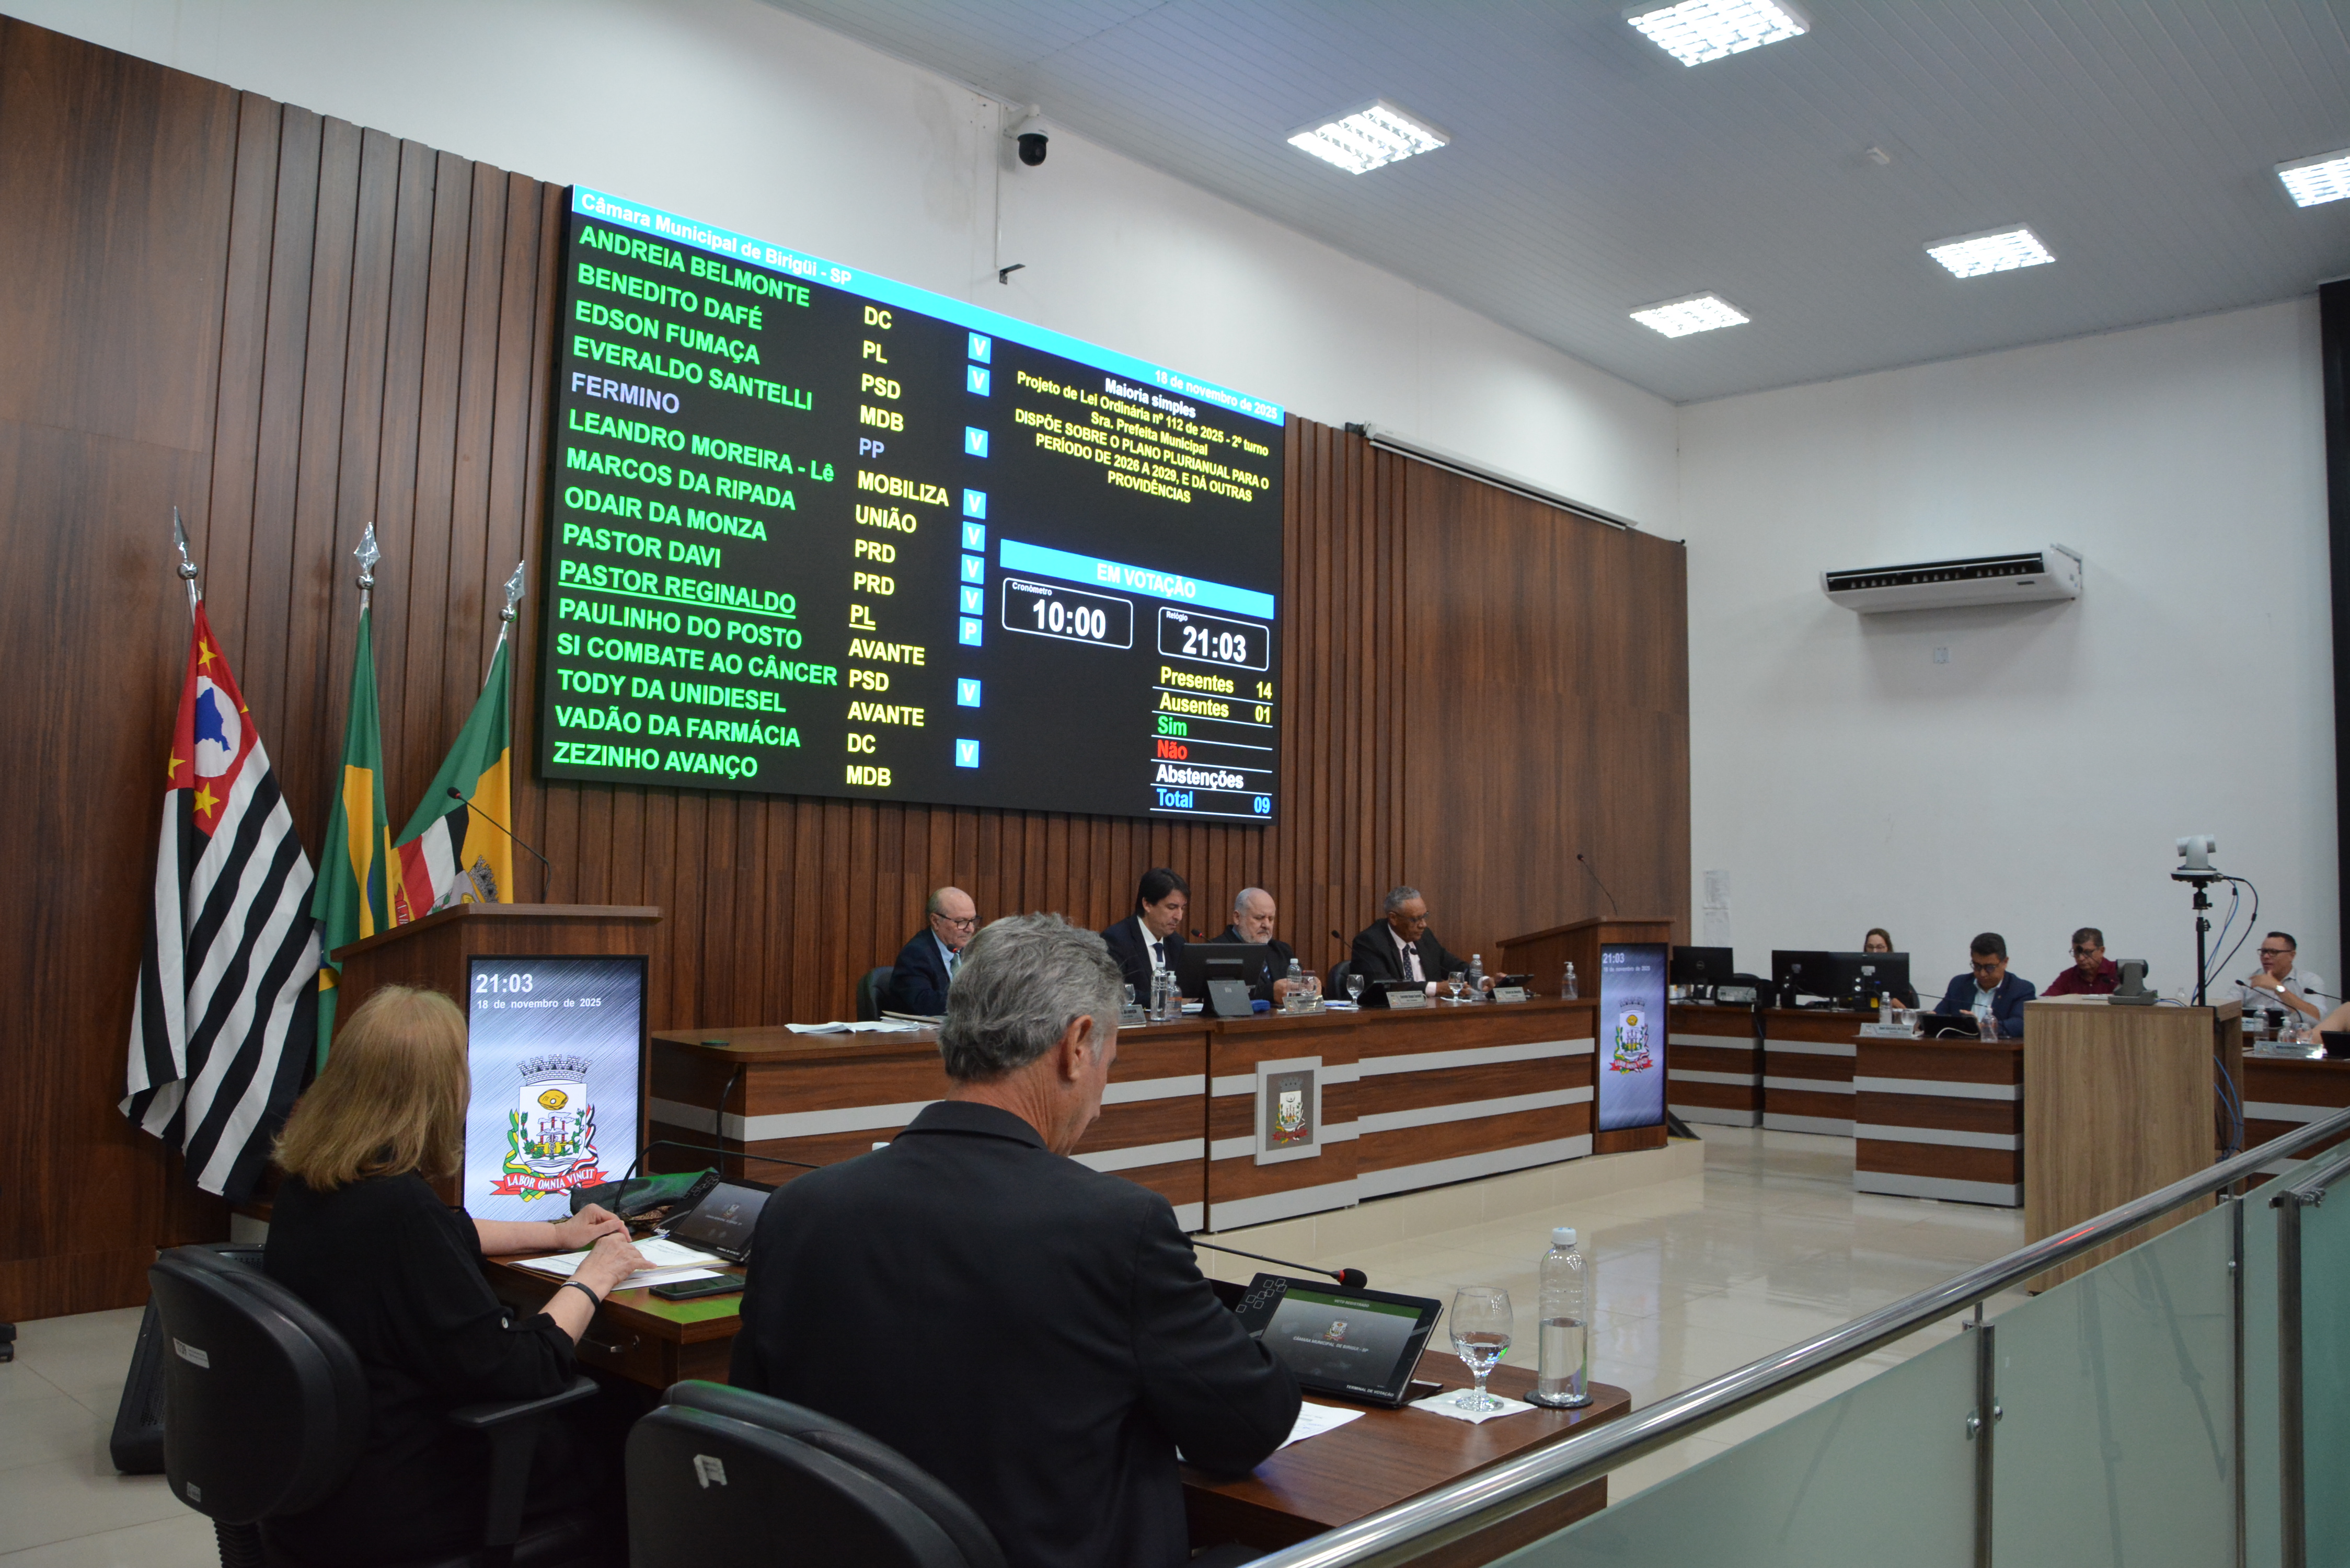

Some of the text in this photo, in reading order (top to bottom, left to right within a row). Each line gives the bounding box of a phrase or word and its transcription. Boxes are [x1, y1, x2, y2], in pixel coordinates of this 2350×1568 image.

[582, 194, 650, 227] Câmara
[655, 214, 737, 253] Municipal
[741, 242, 761, 259] de
[766, 248, 816, 276] Birigüi
[830, 268, 851, 285] SP
[579, 225, 810, 307] ANDREIA BELMONTE
[578, 263, 762, 330] BENEDITO DAFÉ
[865, 306, 892, 329] DC
[575, 300, 760, 365] EDSON FUMAÇA
[863, 340, 888, 364] PL
[974, 338, 986, 356] V
[573, 335, 812, 410] EVERALDO SANTELLI
[862, 373, 901, 399] PSD
[973, 371, 985, 389] V
[572, 372, 679, 413] FERMINO
[1105, 378, 1196, 418] Maioria simples
[1155, 370, 1277, 419] 18 de novembro de 2025
[860, 405, 904, 432] MDB
[1018, 371, 1060, 395] Projeto
[1063, 386, 1077, 400] de
[1081, 389, 1097, 406] Lei
[1100, 396, 1150, 421] Ordinária
[1153, 413, 1164, 424] nº
[1166, 416, 1183, 431] 112
[1185, 422, 1198, 435] de
[1200, 426, 1224, 443] 2025
[1231, 435, 1242, 447] 2º
[1243, 439, 1269, 456] turno
[569, 409, 685, 451] LEANDRO
[692, 434, 792, 474] MOREIRA
[811, 460, 834, 482] Lê
[859, 437, 884, 458] PP
[971, 432, 983, 450] V
[1091, 412, 1207, 456] Sra. Prefeita Municipal
[1016, 409, 1269, 489] DISPÕE SOBRE O PLANO PLURIANUAL PARA O
[567, 447, 796, 510] MARCOS DA RIPADA
[1036, 433, 1252, 502] PERÍODO DE 2026 A 2029, E DÁ OUTRAS
[858, 470, 949, 506] MOBILIZA
[1108, 470, 1191, 503] PROVIDÊNCIAS
[565, 487, 767, 541] ODAIR DA MONZA
[969, 494, 981, 512] V
[856, 504, 916, 533] UNIÃO
[563, 523, 720, 568] PASTOR DAVI
[967, 527, 980, 545] V
[855, 539, 895, 563] PRD
[966, 560, 979, 578] V
[1098, 563, 1195, 598] EM VOTAÇÃO
[560, 560, 796, 614] PASTOR REGINALDO
[854, 572, 894, 595] PRD
[1012, 582, 1052, 596] Cronômetro
[965, 591, 978, 608] V
[559, 598, 802, 649] PAULINHO DO POSTO
[851, 604, 876, 624] PL
[1033, 599, 1105, 639] 10:00
[1166, 611, 1188, 622] Relógio
[965, 622, 977, 639] P
[1182, 626, 1246, 662] 21:03
[557, 633, 837, 686] SI COMBATE AO CÂNCER
[848, 638, 925, 665] AVANTE
[557, 669, 786, 712] TODY DA UNIDIESEL
[849, 669, 889, 691] PSD
[963, 683, 976, 701] V
[1161, 666, 1272, 699] Presentes 14
[848, 701, 924, 727] AVANTE
[1160, 692, 1270, 723] Ausentes 01
[555, 705, 800, 747] VADÃO DA FARMÁCIA
[1157, 716, 1187, 736] Sim
[848, 733, 876, 753] DC
[961, 744, 974, 762] V
[1157, 739, 1188, 759] Não
[553, 742, 757, 779] ZEZINHO AVANÇO
[847, 765, 891, 786] MDB
[1156, 764, 1244, 790] Abstenções
[1156, 788, 1270, 814] Total 09
[1603, 953, 1625, 964] 21:03
[476, 974, 533, 993] 21:03
[477, 998, 601, 1009] 18 de novembro de 2025
[506, 1169, 595, 1190] LABOR OMNIA VINCIT
